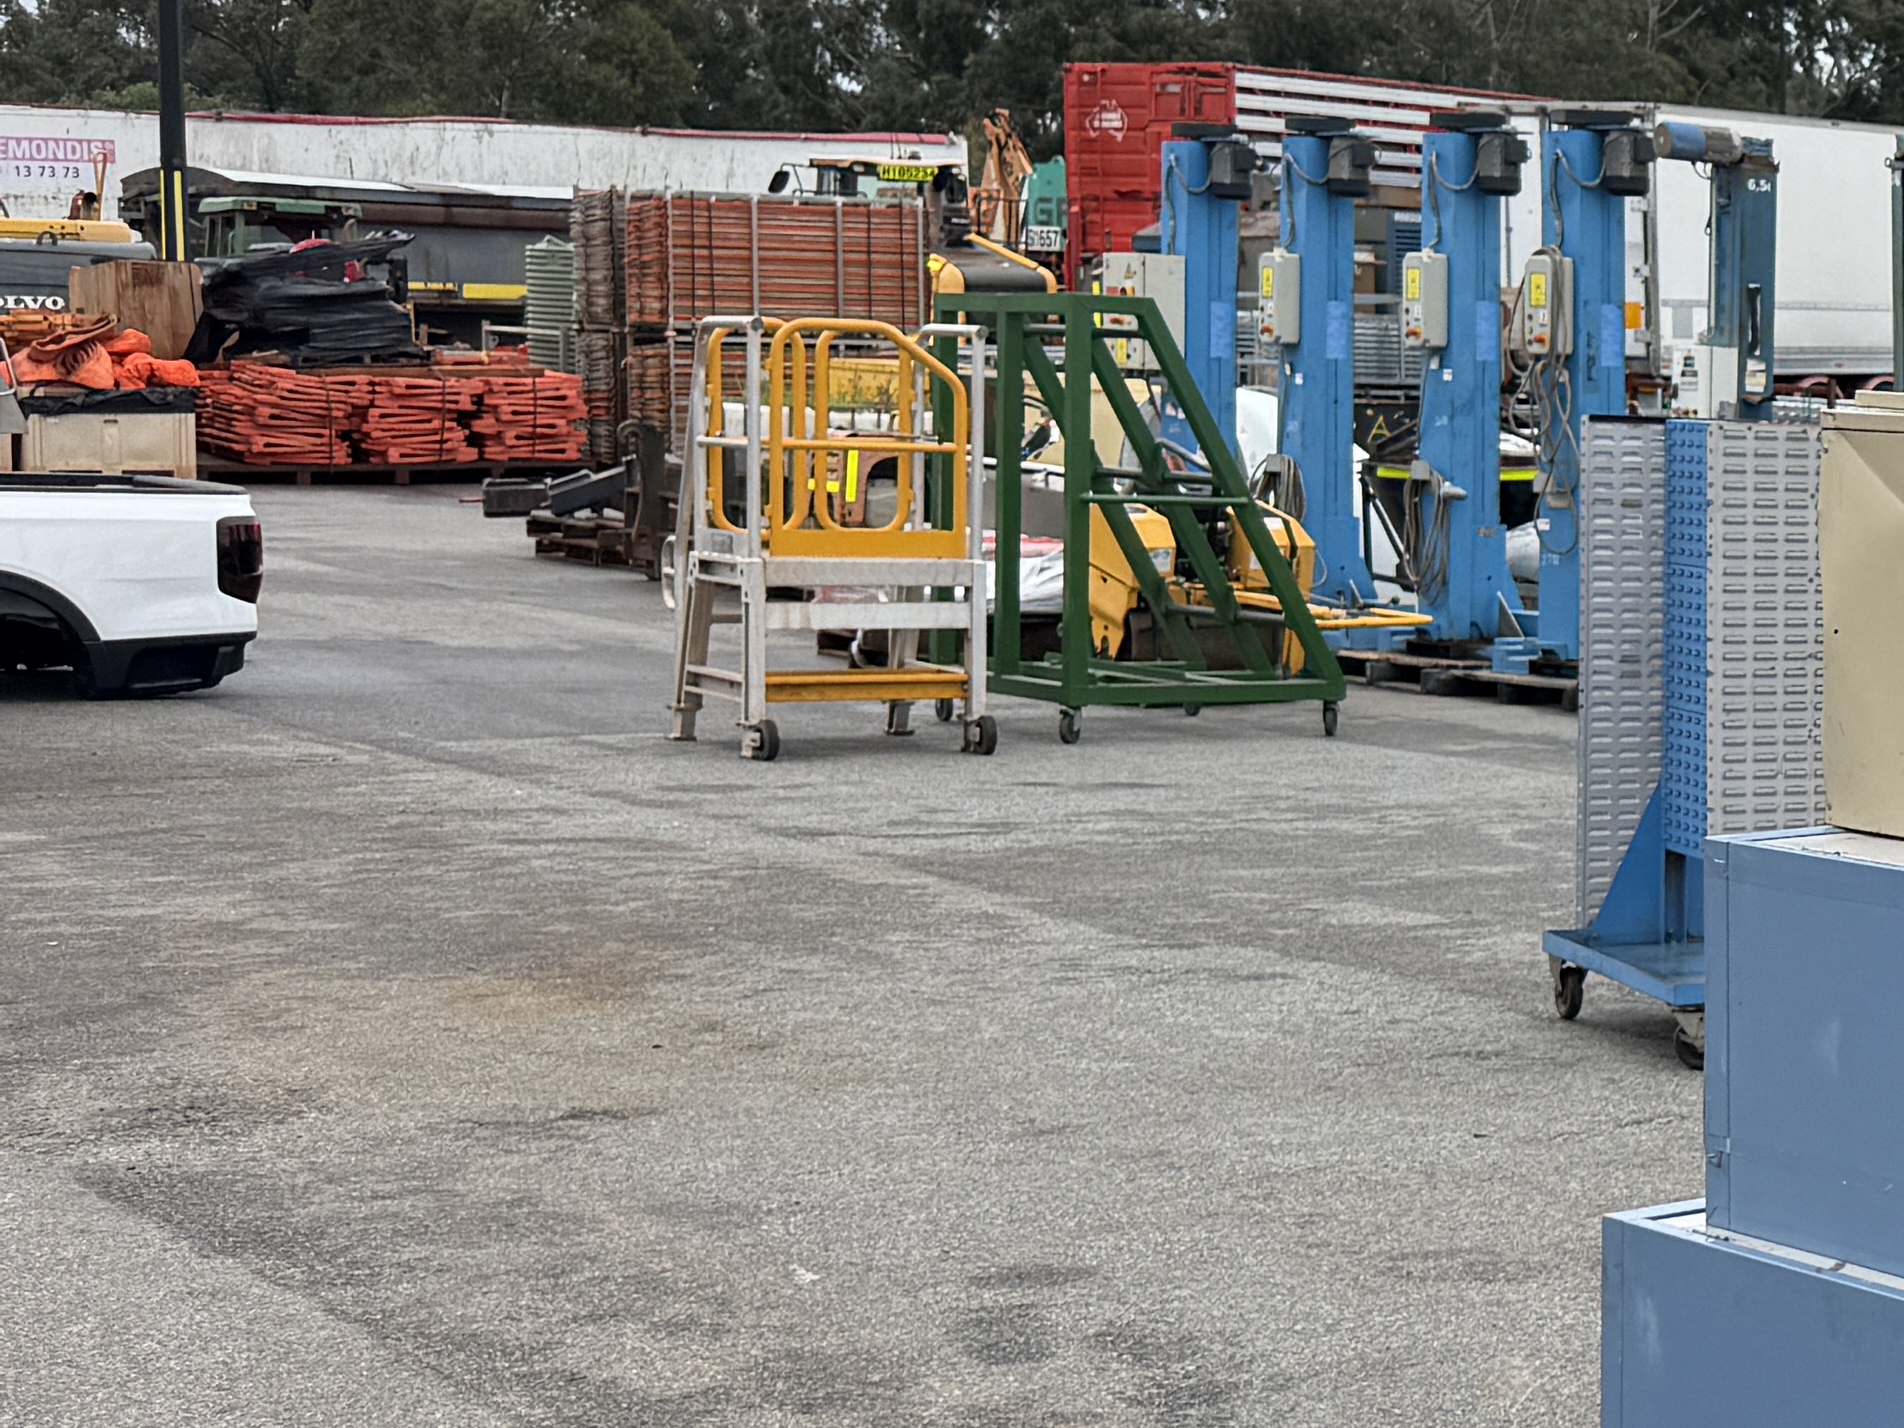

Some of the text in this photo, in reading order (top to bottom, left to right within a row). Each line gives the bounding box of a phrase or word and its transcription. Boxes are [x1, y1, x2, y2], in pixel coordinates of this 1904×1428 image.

[38, 165, 56, 177] 73
[62, 166, 80, 178] 73
[0, 295, 65, 310] LVO
